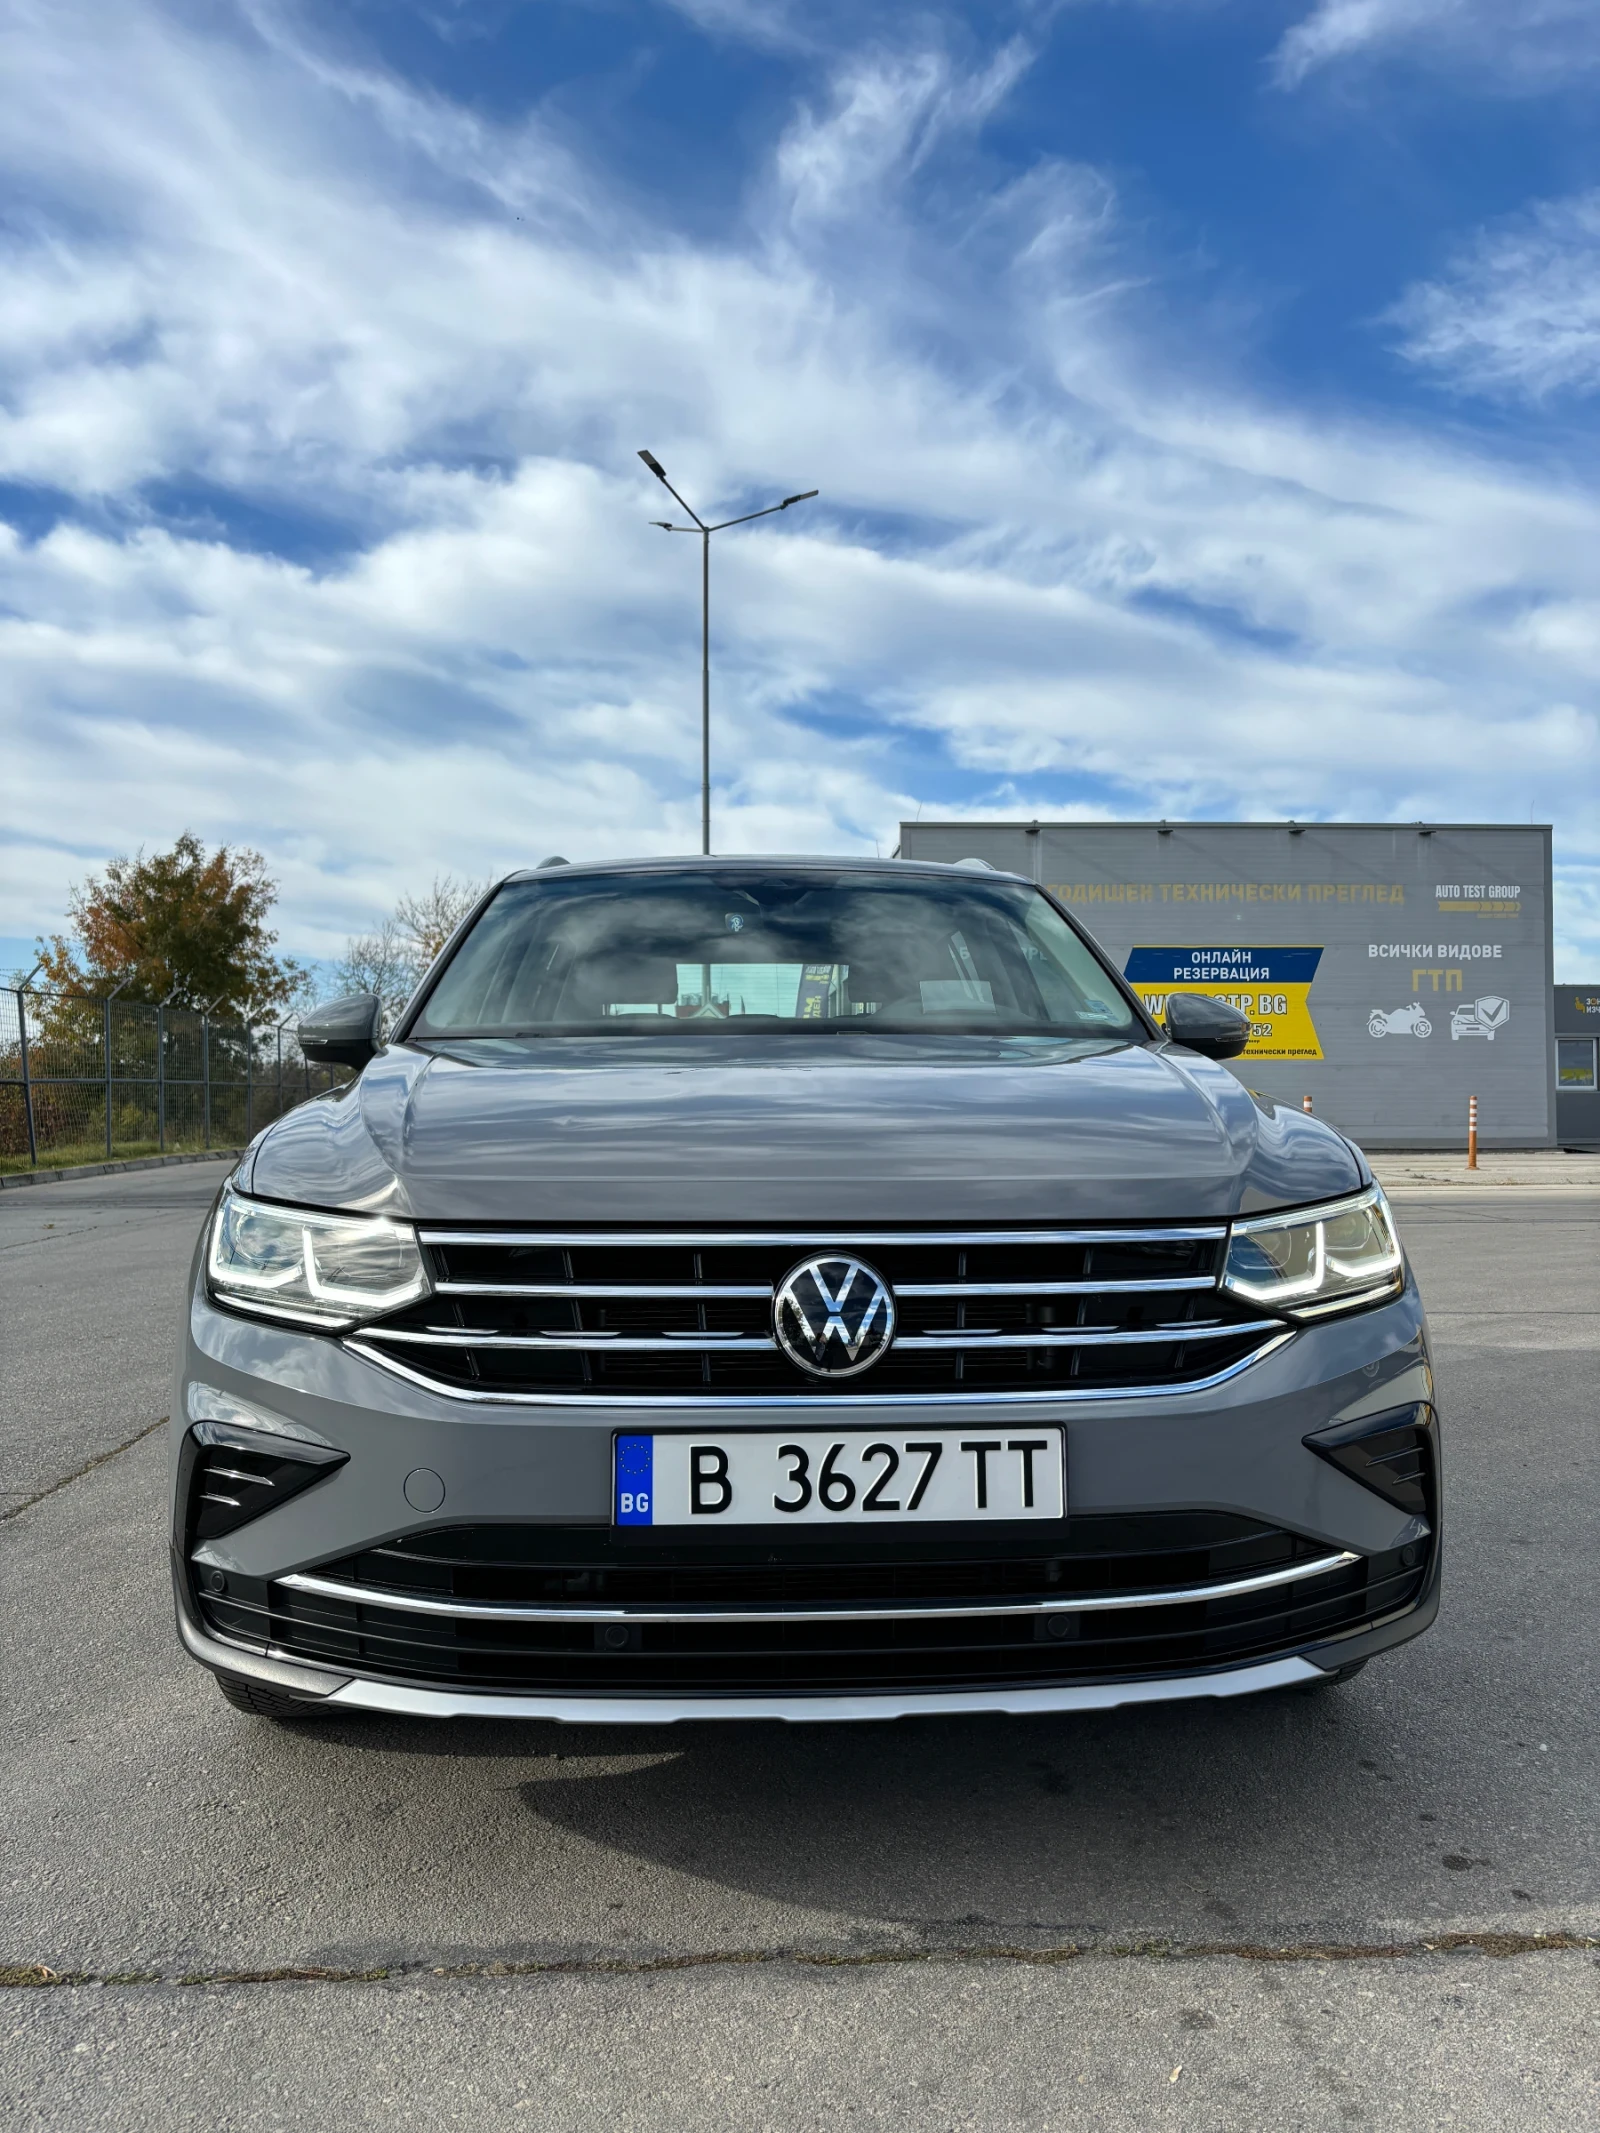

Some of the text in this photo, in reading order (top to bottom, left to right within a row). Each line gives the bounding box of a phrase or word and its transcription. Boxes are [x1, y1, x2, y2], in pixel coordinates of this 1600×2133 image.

[1159, 884, 1300, 904] ТЕХНИЧЕСКИ
[1308, 884, 1405, 905] ПРЕГЛЕД
[1435, 884, 1521, 899] AUTO TEST GROUP
[1191, 949, 1252, 964] ОНЛАЙН
[1368, 944, 1502, 960] ВСИЧКИ ВИДОВЕ
[1173, 967, 1269, 981] РЕЗЕРВАЦИЯ
[1411, 968, 1463, 992] ГТП
[690, 1444, 733, 1515] B
[773, 1442, 943, 1513] 3627
[620, 1492, 649, 1513] BG
